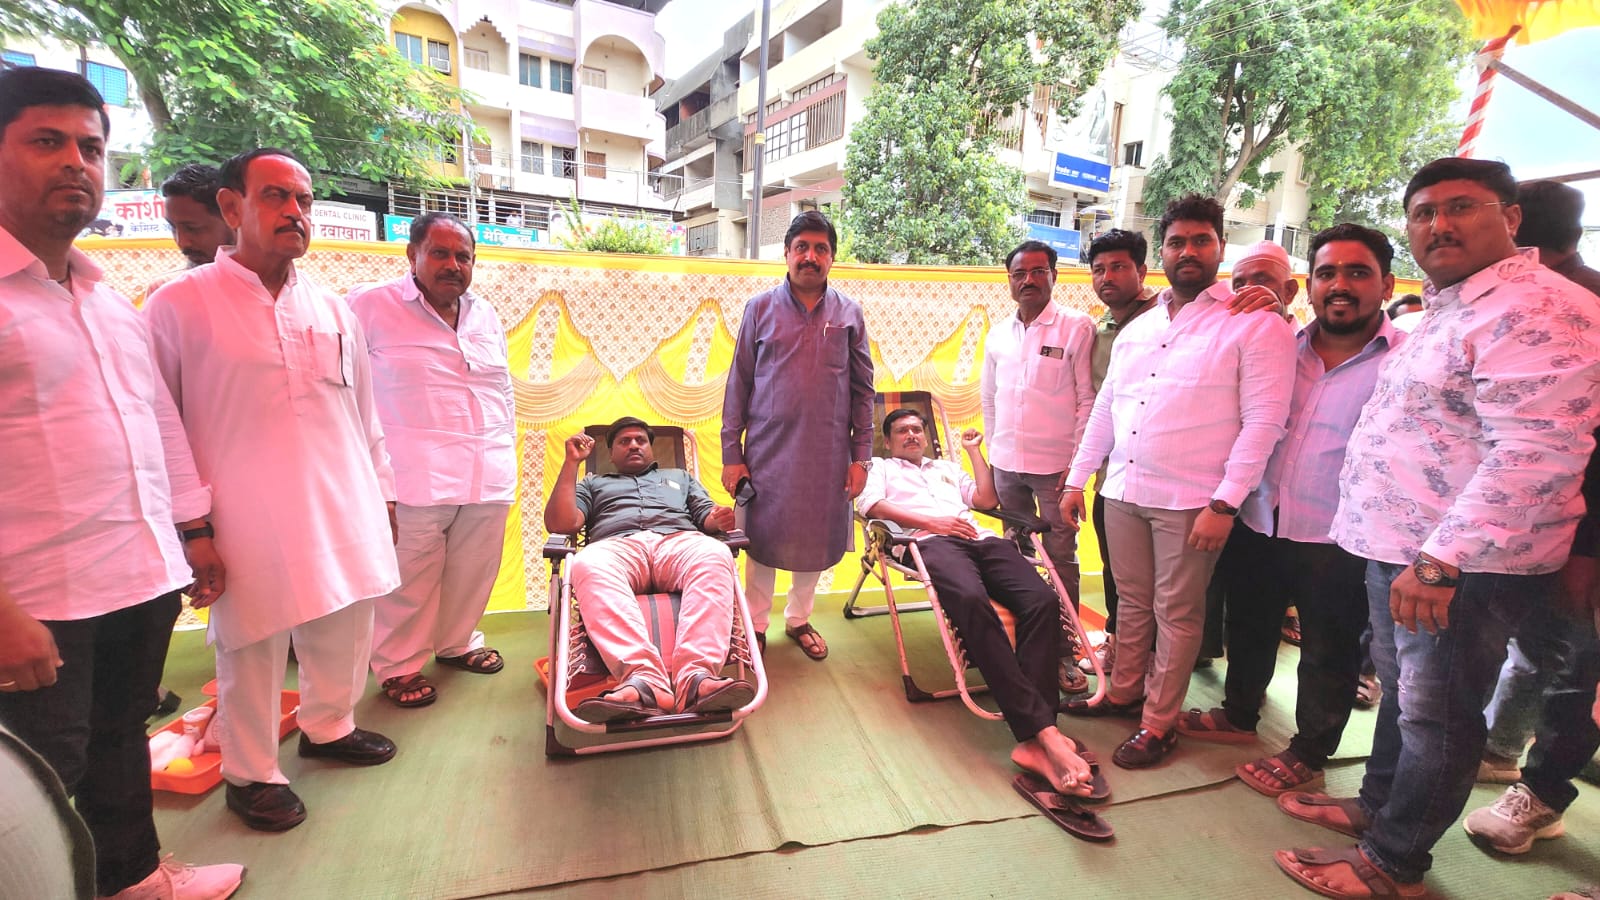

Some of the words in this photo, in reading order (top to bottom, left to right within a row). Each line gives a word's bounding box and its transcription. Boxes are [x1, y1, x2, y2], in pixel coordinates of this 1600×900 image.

[314, 209, 341, 219] DENTAL
[343, 212, 367, 222] CLINIC
[319, 223, 371, 241] दवाखाना
